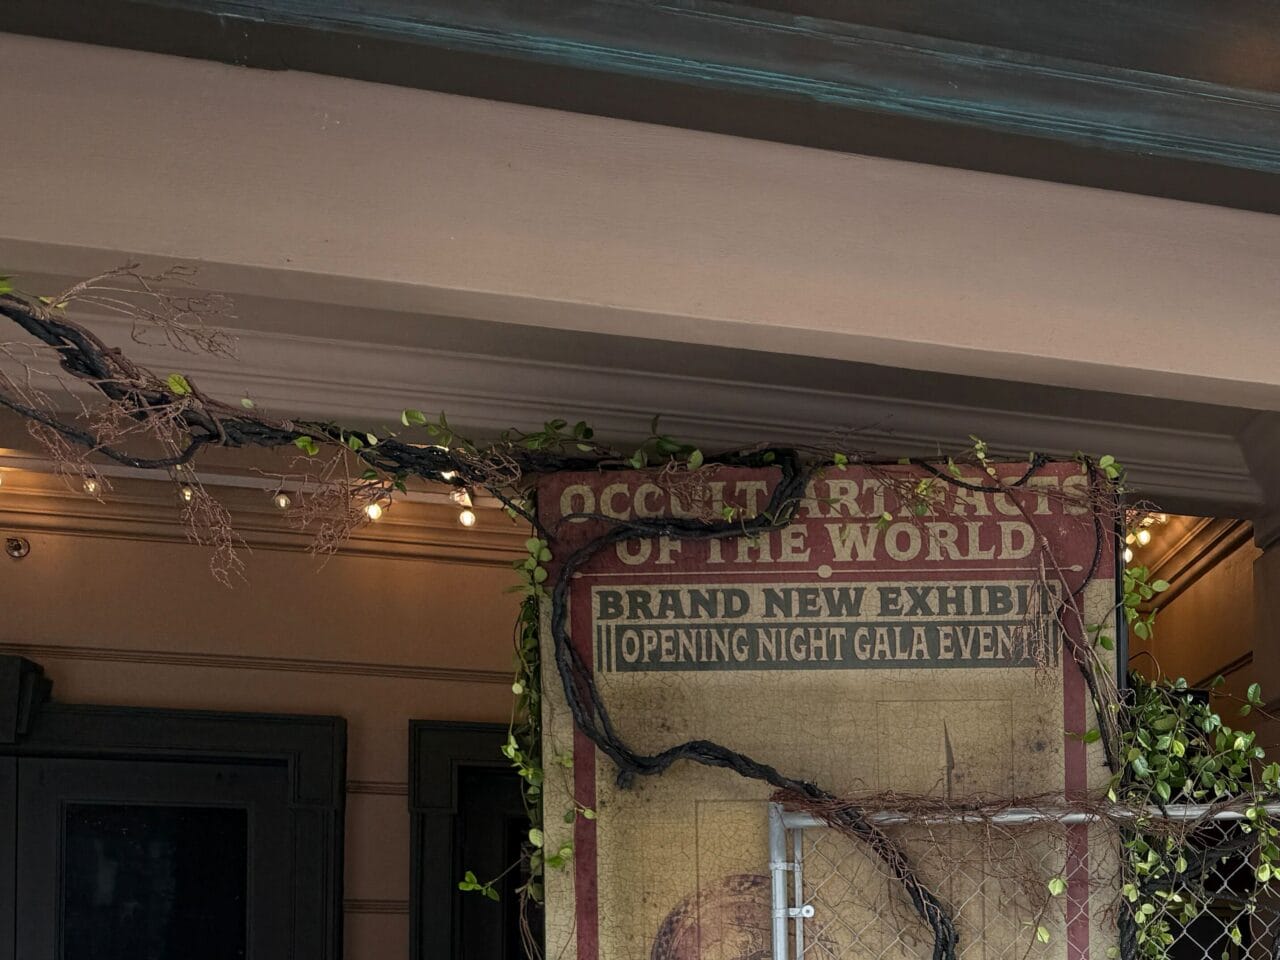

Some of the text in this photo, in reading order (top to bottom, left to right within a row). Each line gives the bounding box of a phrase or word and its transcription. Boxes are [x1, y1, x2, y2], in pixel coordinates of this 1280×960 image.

[824, 520, 1036, 563] WORLD
[595, 583, 1059, 621] BRAND NEW EXHIBIT
[620, 624, 1033, 664] OPENING NIGHT GALA EVENT
